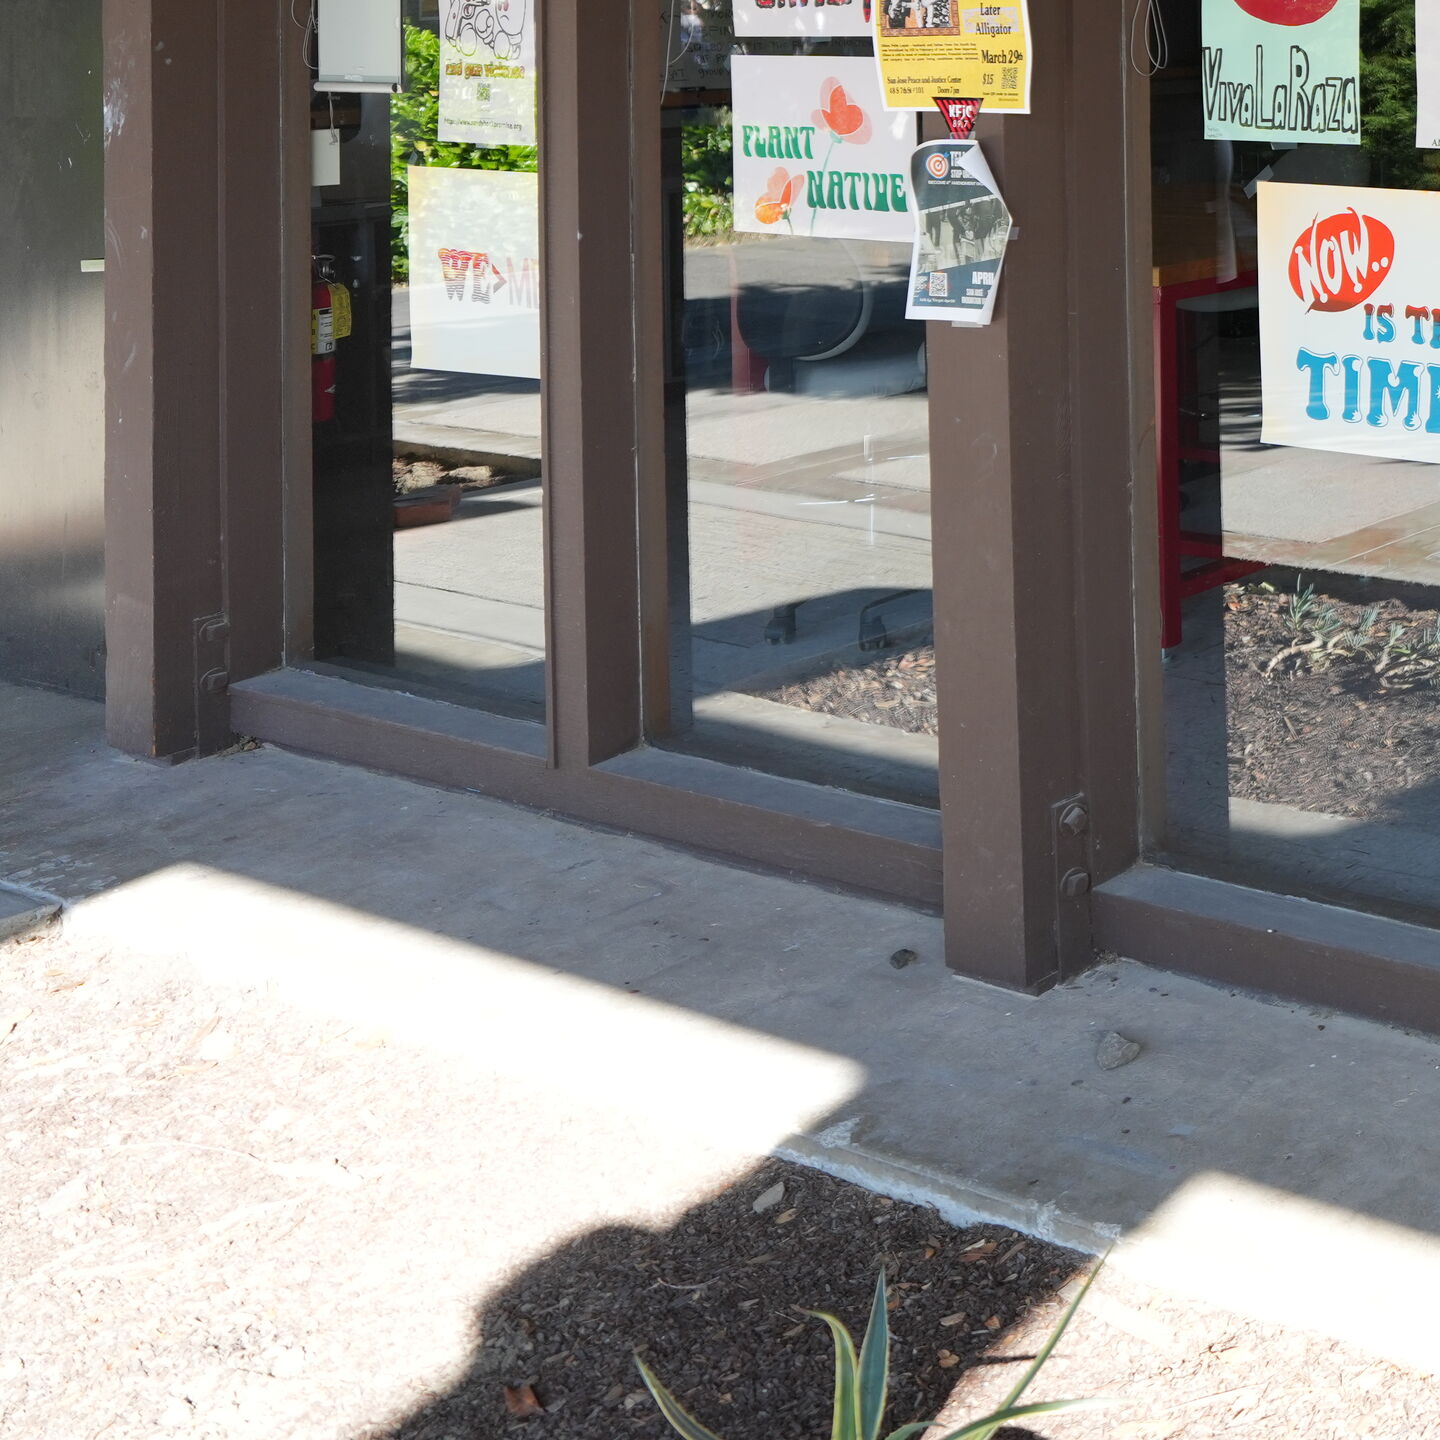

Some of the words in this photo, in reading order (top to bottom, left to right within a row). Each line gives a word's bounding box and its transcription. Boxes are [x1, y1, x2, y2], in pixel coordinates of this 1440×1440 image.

[980, 2, 1001, 16] Later
[975, 21, 1012, 38] Alligator
[981, 49, 1007, 64] March
[982, 73, 995, 85] $15
[741, 124, 816, 160] PLANT
[806, 170, 909, 213] NATIVE
[438, 248, 491, 305] WE
[1363, 302, 1396, 344] IS
